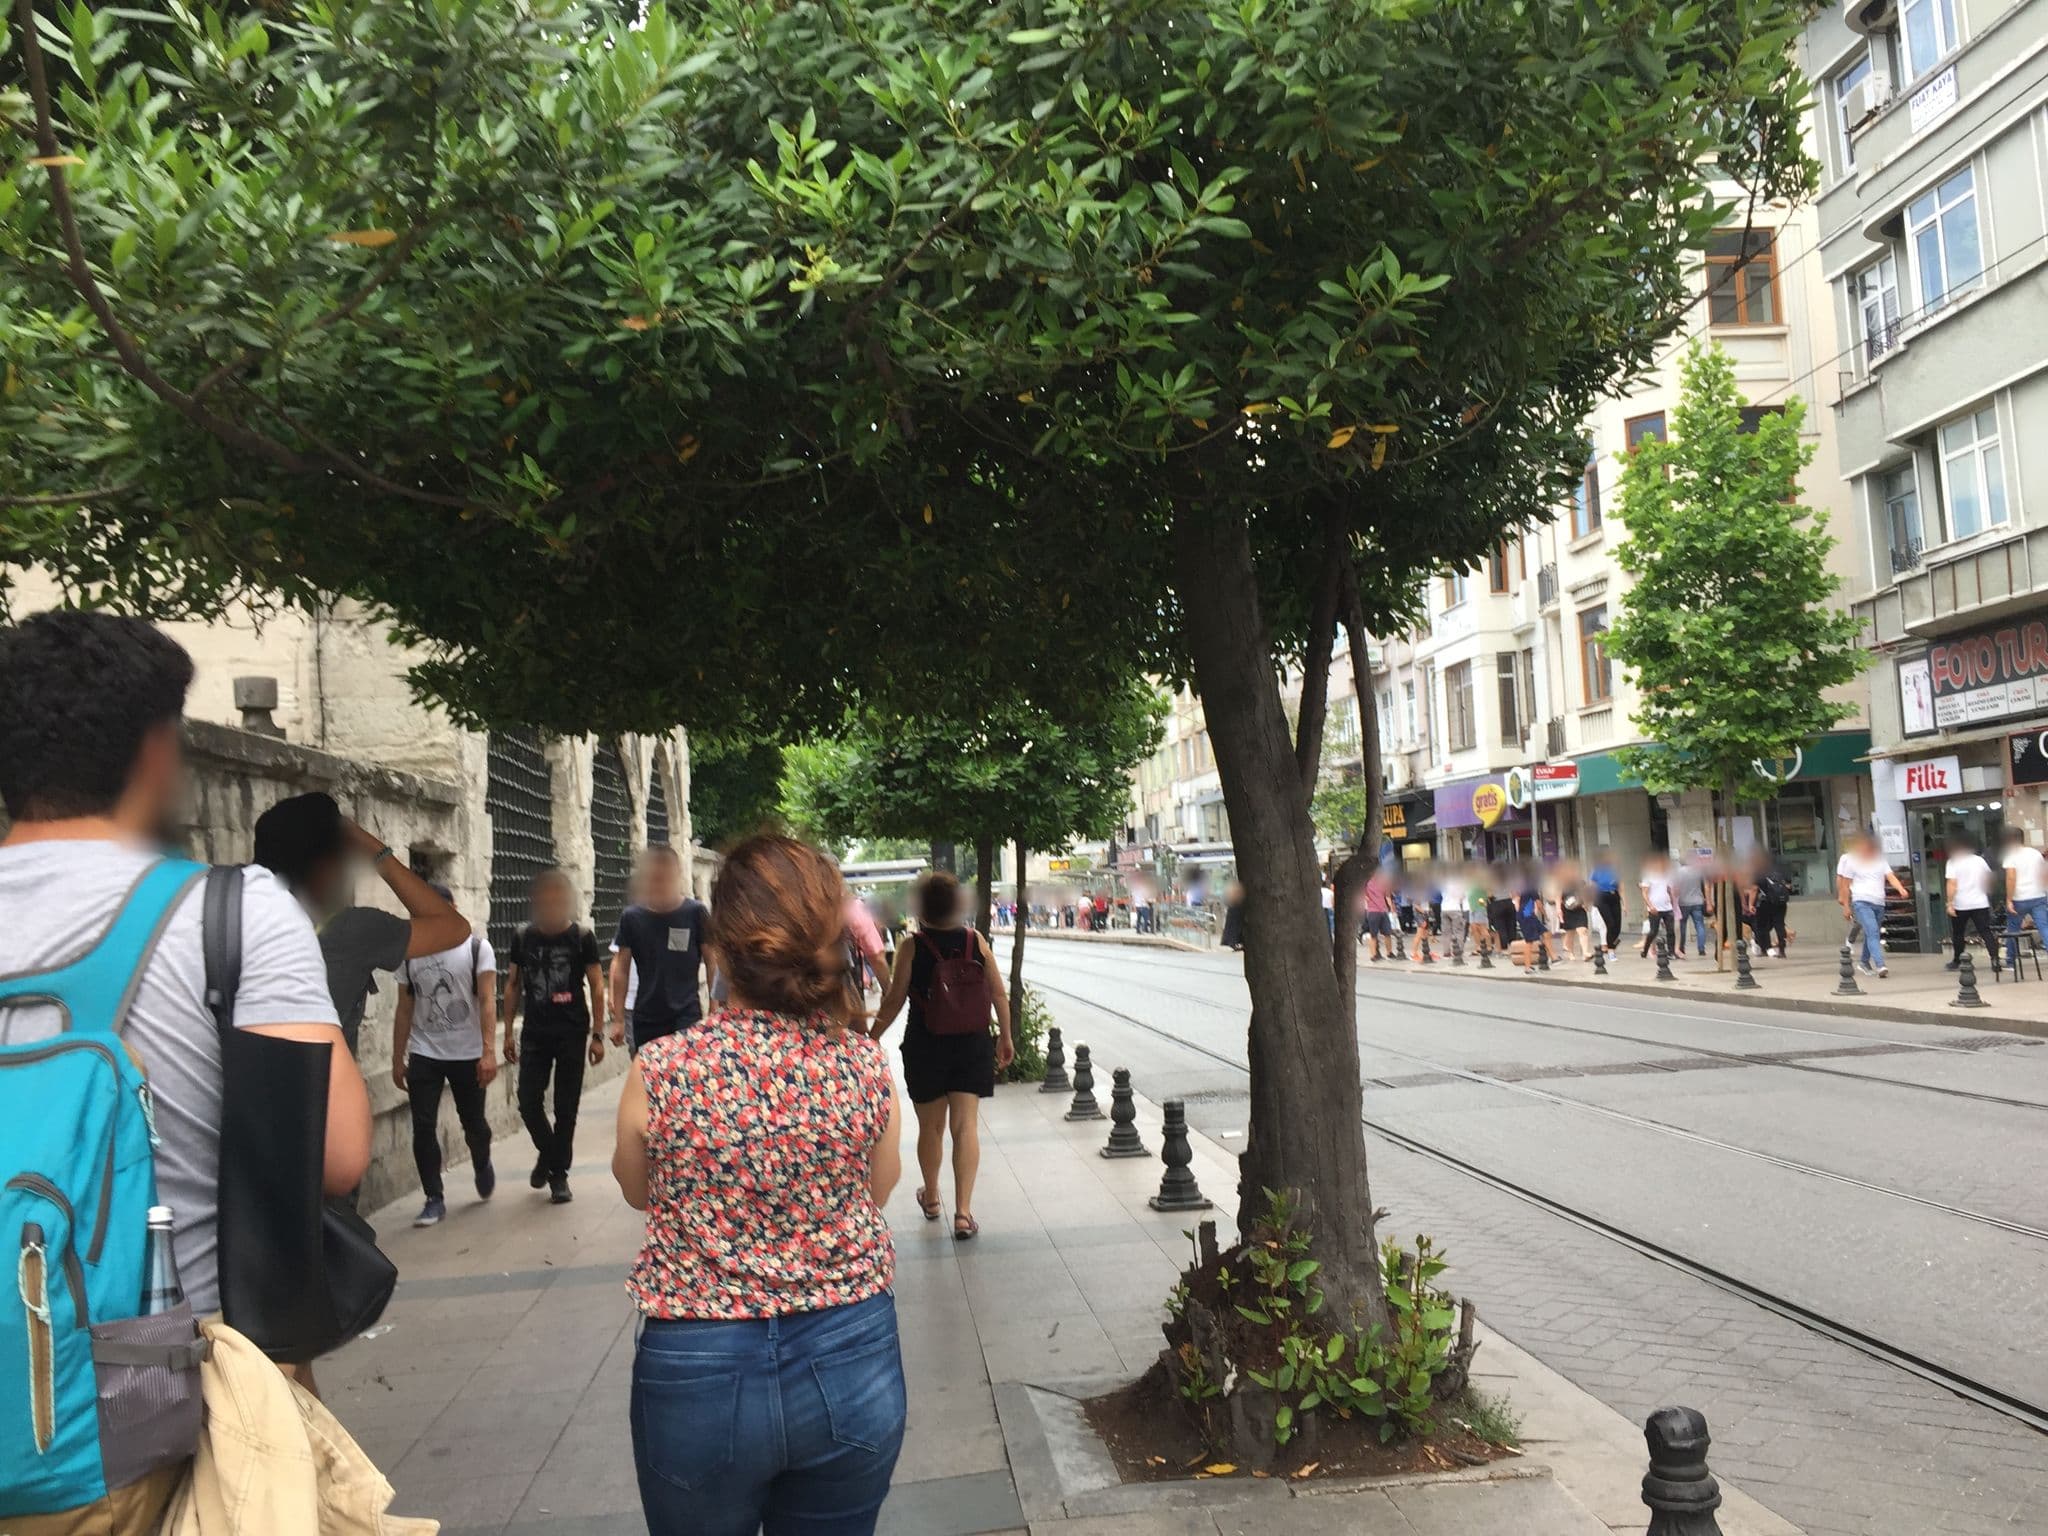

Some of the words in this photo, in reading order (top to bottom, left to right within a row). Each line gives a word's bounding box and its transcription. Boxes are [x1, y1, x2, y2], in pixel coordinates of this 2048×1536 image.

[1932, 73, 1953, 95] KAYA
[1931, 635, 1997, 693] FOTO
[1906, 763, 1948, 793] Filiz
[1475, 789, 1499, 813] gratis
[1383, 804, 1405, 826] UPA
